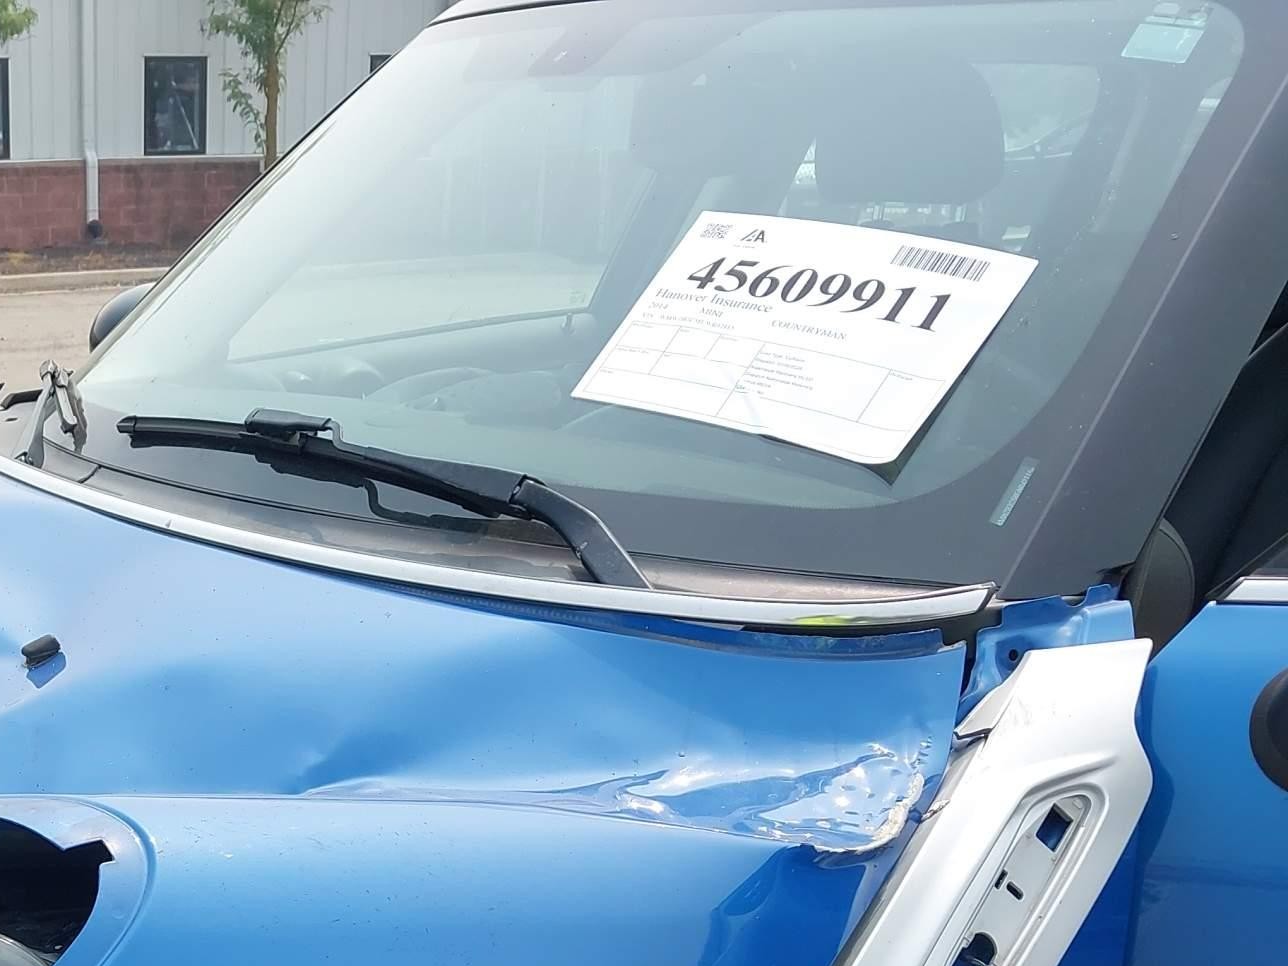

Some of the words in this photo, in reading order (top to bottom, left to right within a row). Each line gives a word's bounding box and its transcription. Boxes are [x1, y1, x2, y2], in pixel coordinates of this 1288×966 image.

[655, 287, 708, 303] Hanover
[710, 293, 774, 313] Insurance
[687, 256, 952, 332] 45609911
[771, 319, 847, 341] COUNTRYMAN
